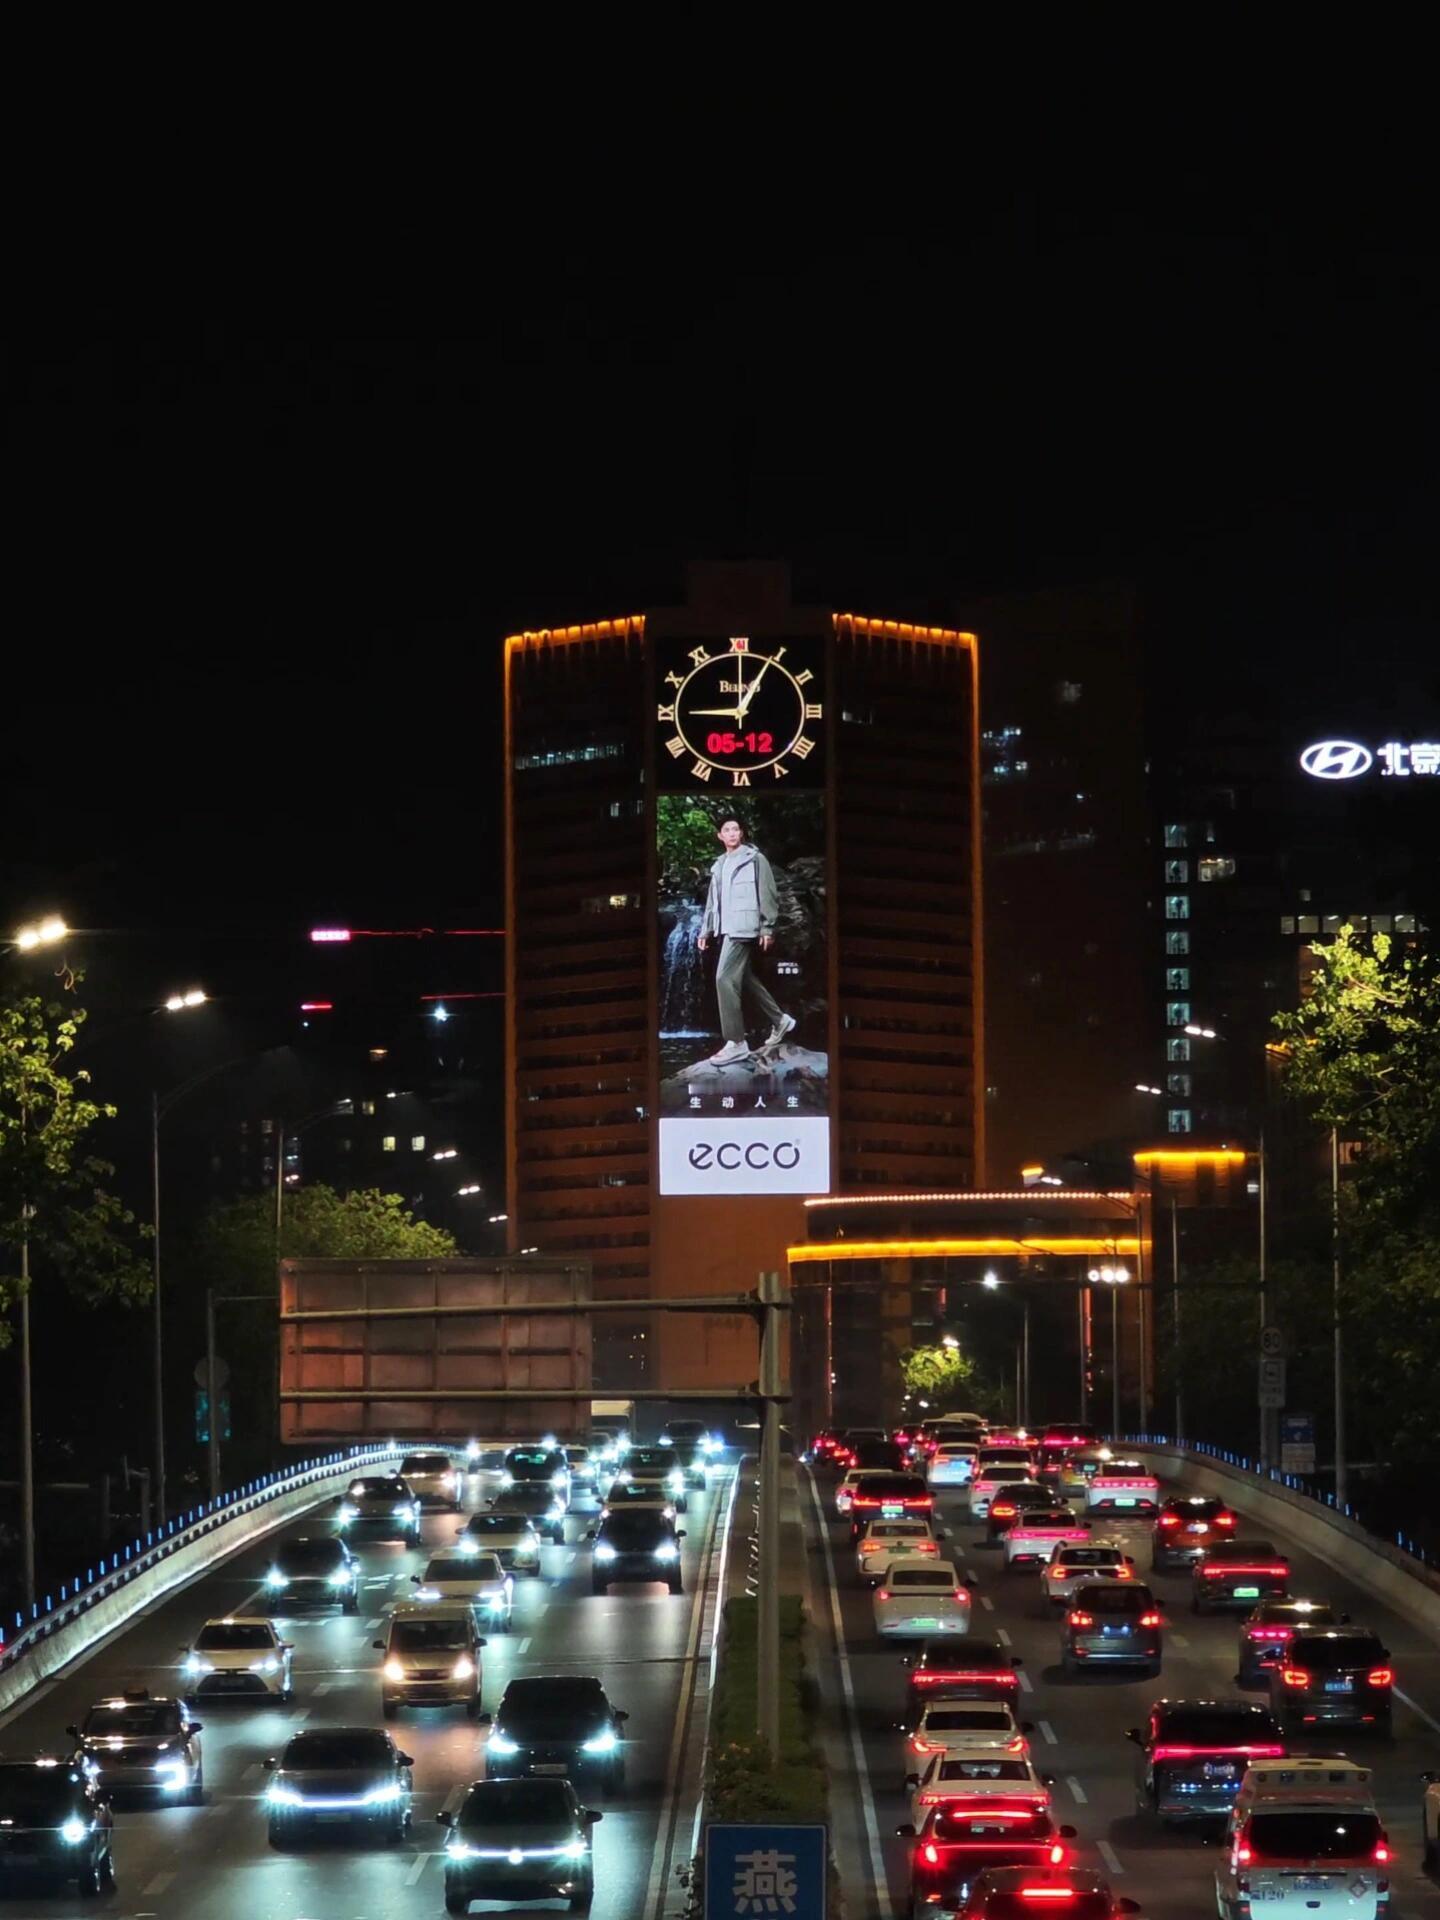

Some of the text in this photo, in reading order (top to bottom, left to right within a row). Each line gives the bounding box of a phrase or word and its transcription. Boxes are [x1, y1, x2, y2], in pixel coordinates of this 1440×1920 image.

[707, 733, 773, 753] 05-12
[689, 1142, 800, 1170] ecco
[732, 1850, 798, 1914] 燕
